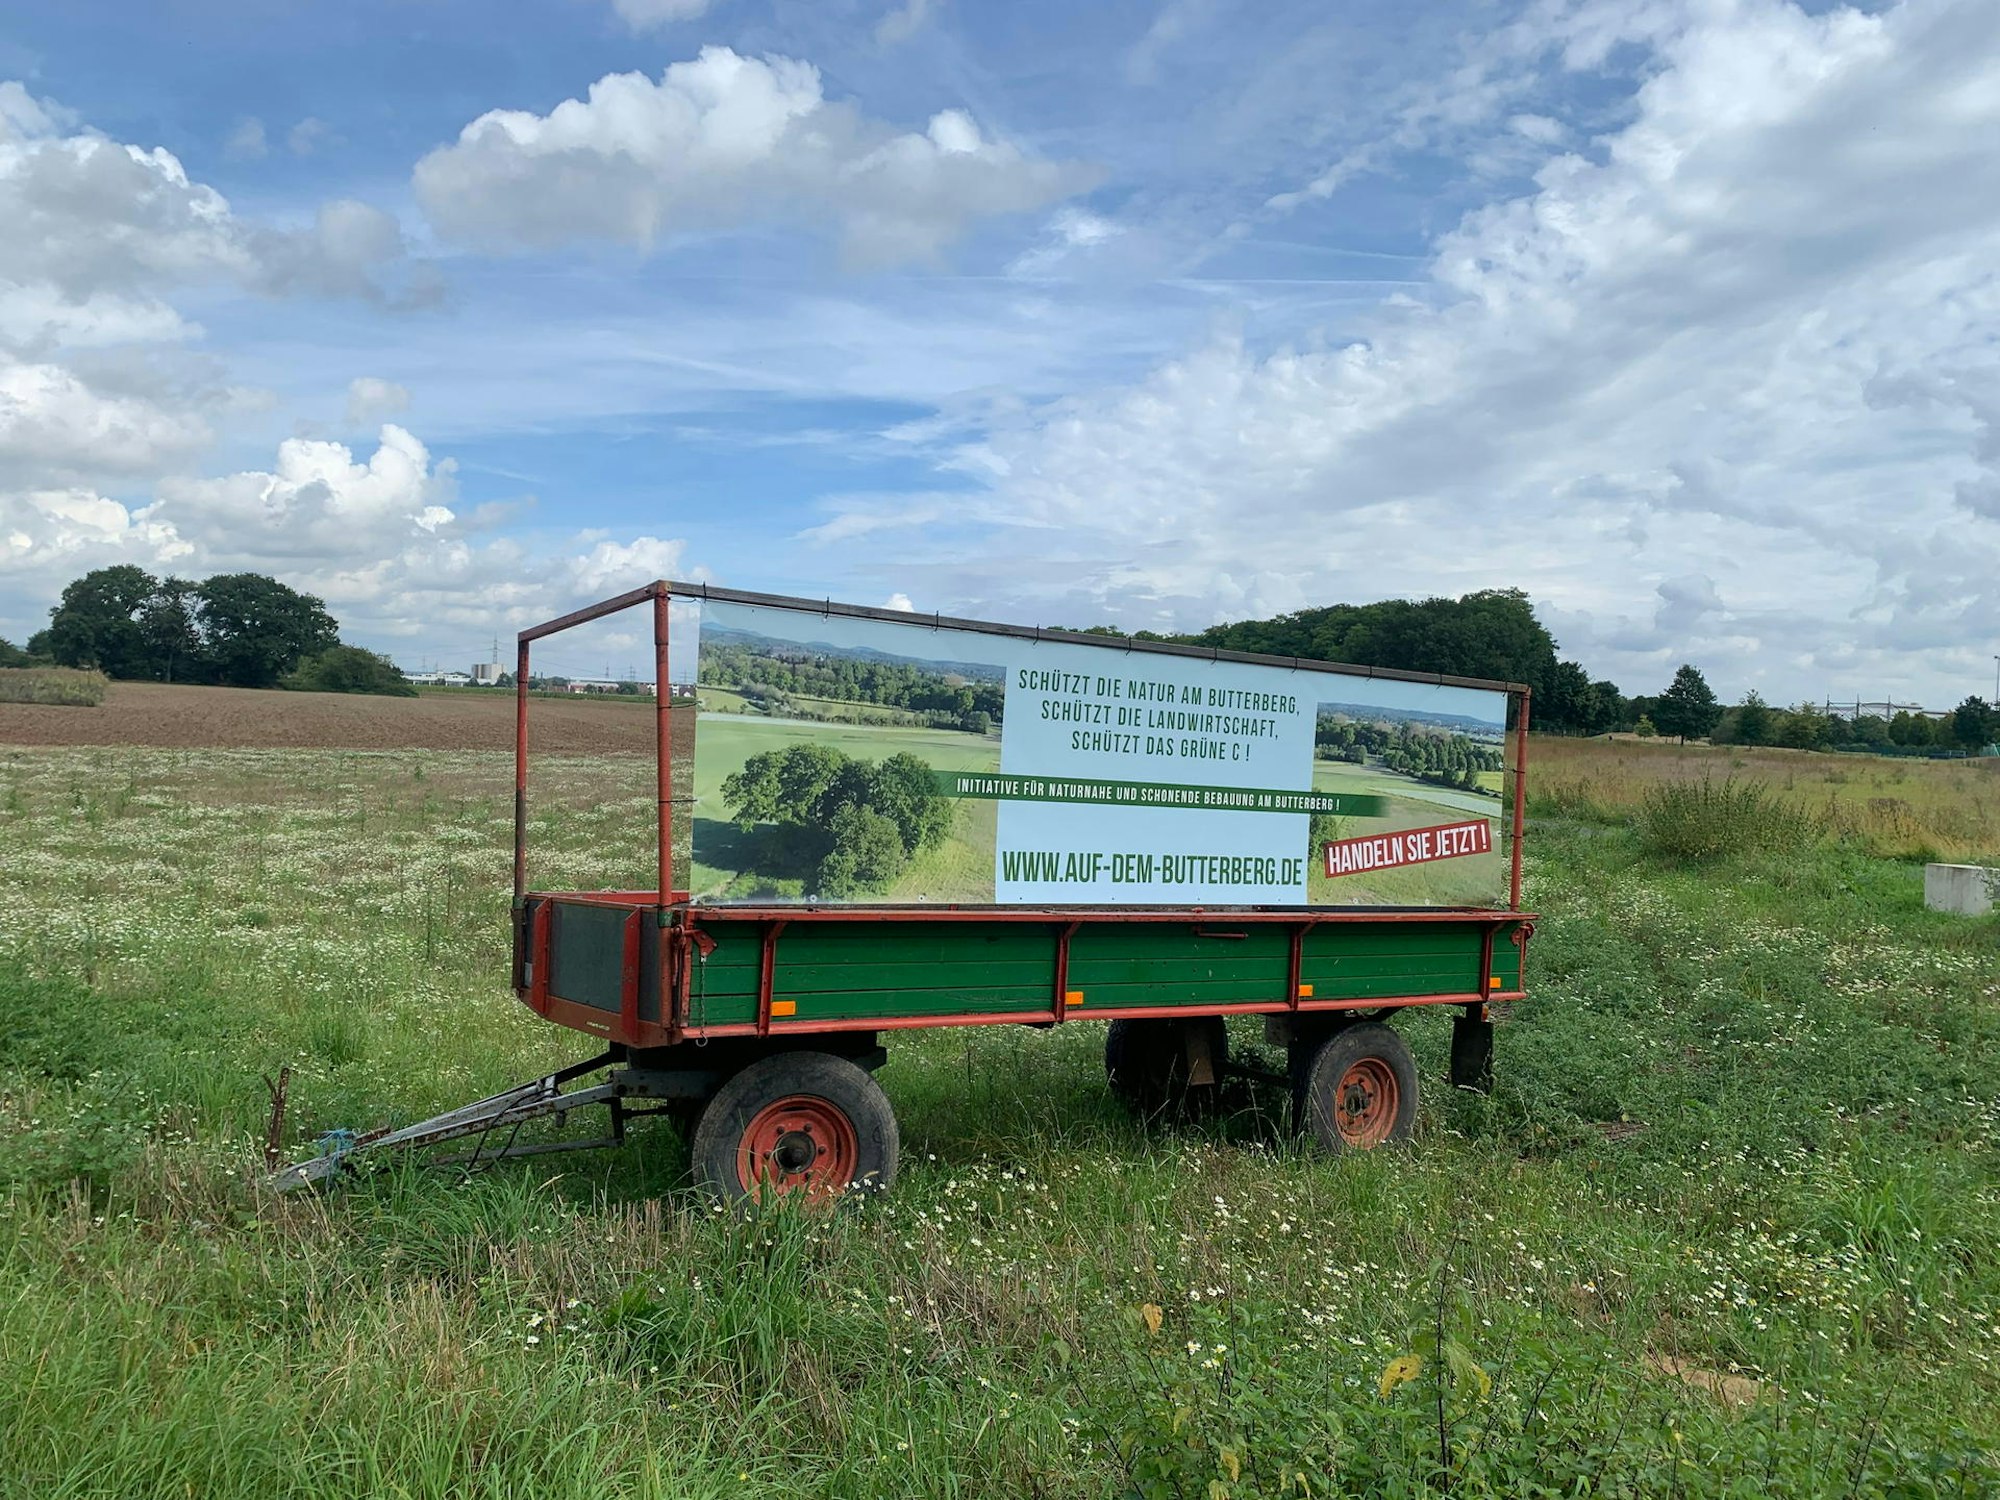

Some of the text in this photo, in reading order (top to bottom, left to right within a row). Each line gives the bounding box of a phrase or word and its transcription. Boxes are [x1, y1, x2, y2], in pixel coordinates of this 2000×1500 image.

[1018, 669, 1300, 716] SCHÜTZT DIE NATUR AM BUTTERBERG,
[1041, 700, 1279, 740] SCHÜTZT DIE LANDWIRTSCHAFT,
[1071, 730, 1140, 755] SCHÜTZT
[1146, 736, 1174, 756] DAS
[1180, 740, 1226, 760] GRÜNE
[1231, 743, 1240, 761] C
[957, 778, 1019, 795] INITIATIVE
[1023, 780, 1045, 796] FÜR
[1049, 783, 1112, 799] NATURNAHE
[1116, 787, 1137, 800] UND
[1141, 788, 1200, 804] SCHONENDE
[1204, 791, 1254, 806] BEBAUUNG
[1258, 795, 1272, 807] AM
[1275, 796, 1333, 811] BUTTERBERG
[1002, 851, 1303, 885] WWW.AUF-DEM-BUTTERBERG.DE
[1328, 836, 1404, 874] HANDELN
[1406, 832, 1431, 861] SIE
[1434, 825, 1477, 857] JETZT
